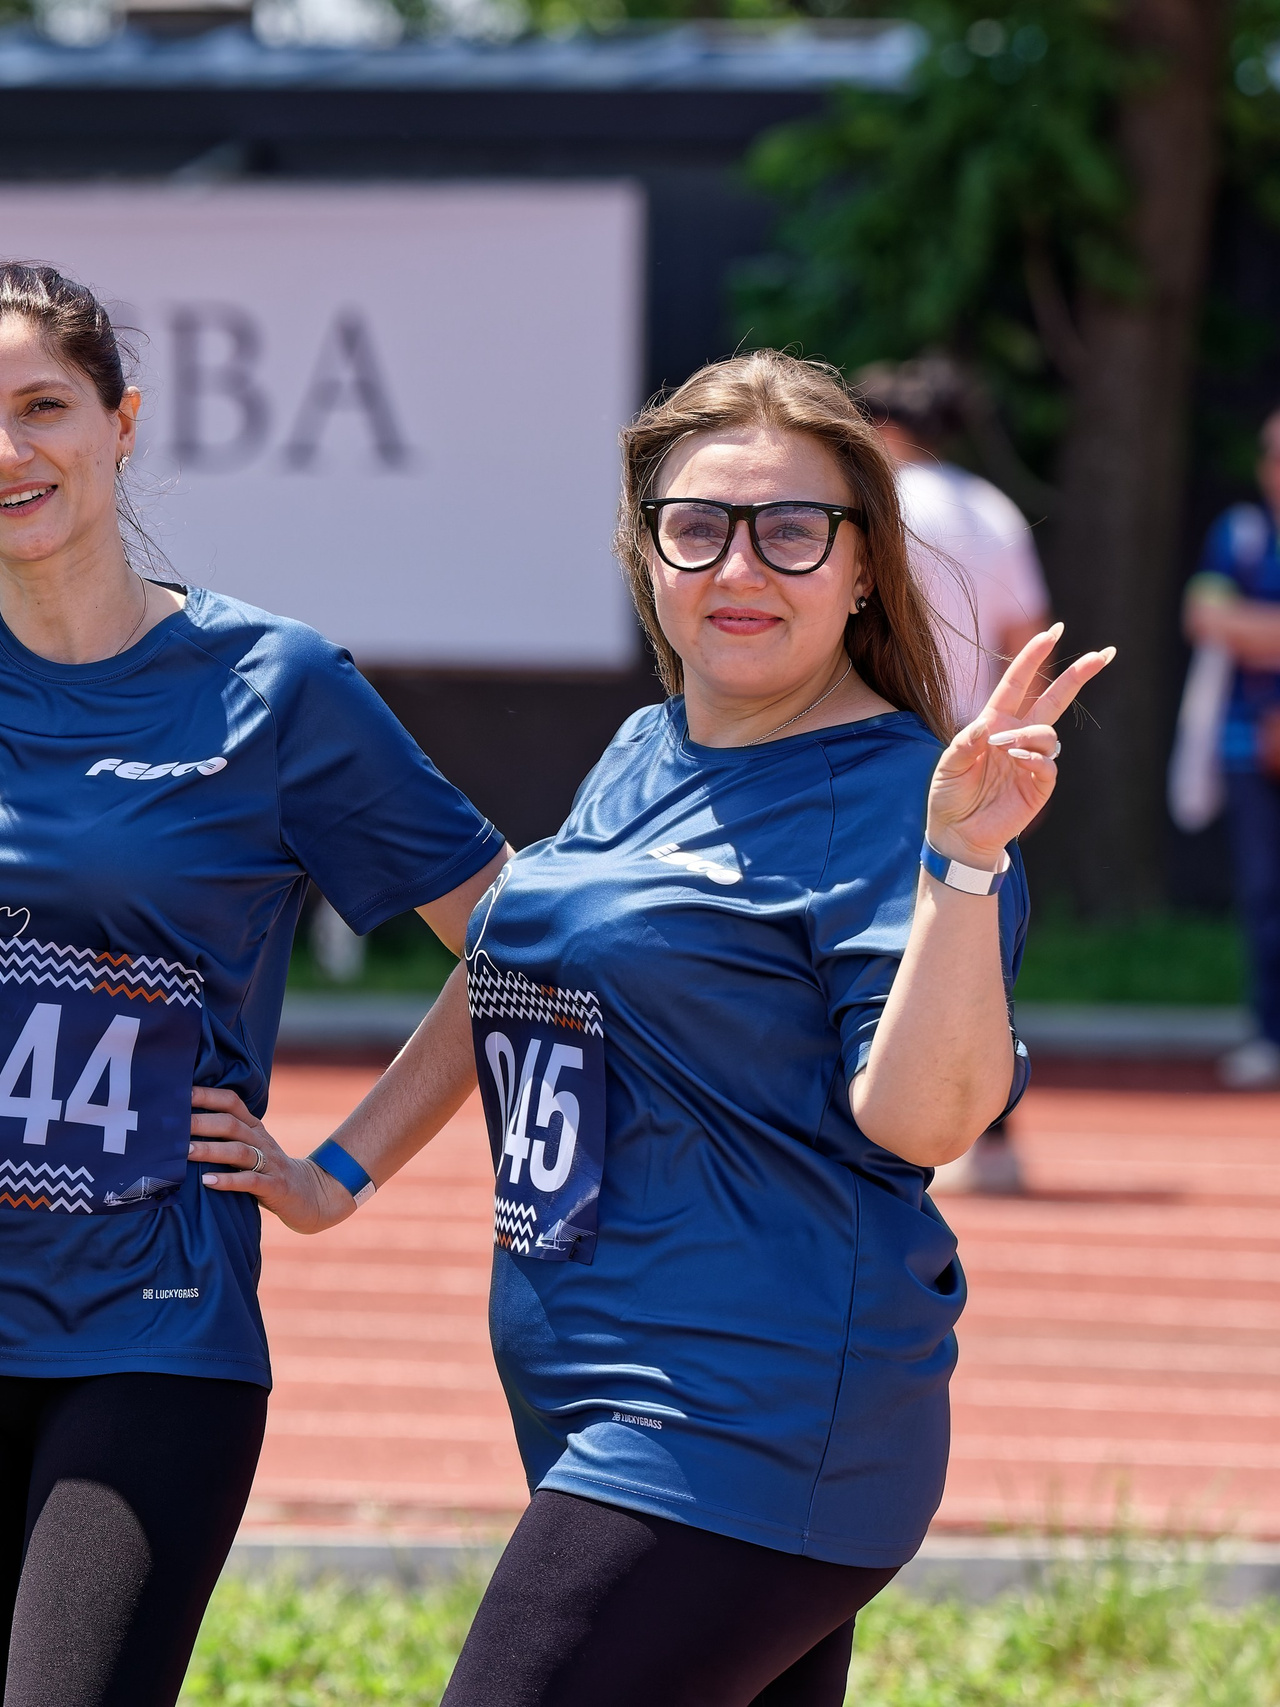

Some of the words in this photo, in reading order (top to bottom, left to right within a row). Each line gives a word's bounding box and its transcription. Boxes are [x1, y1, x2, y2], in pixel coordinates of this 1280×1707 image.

[85, 756, 228, 781] FESCO
[485, 1031, 584, 1192] 045
[155, 1287, 200, 1300] LUCKYGRASS
[621, 1413, 663, 1430] LUCKYGRASS
